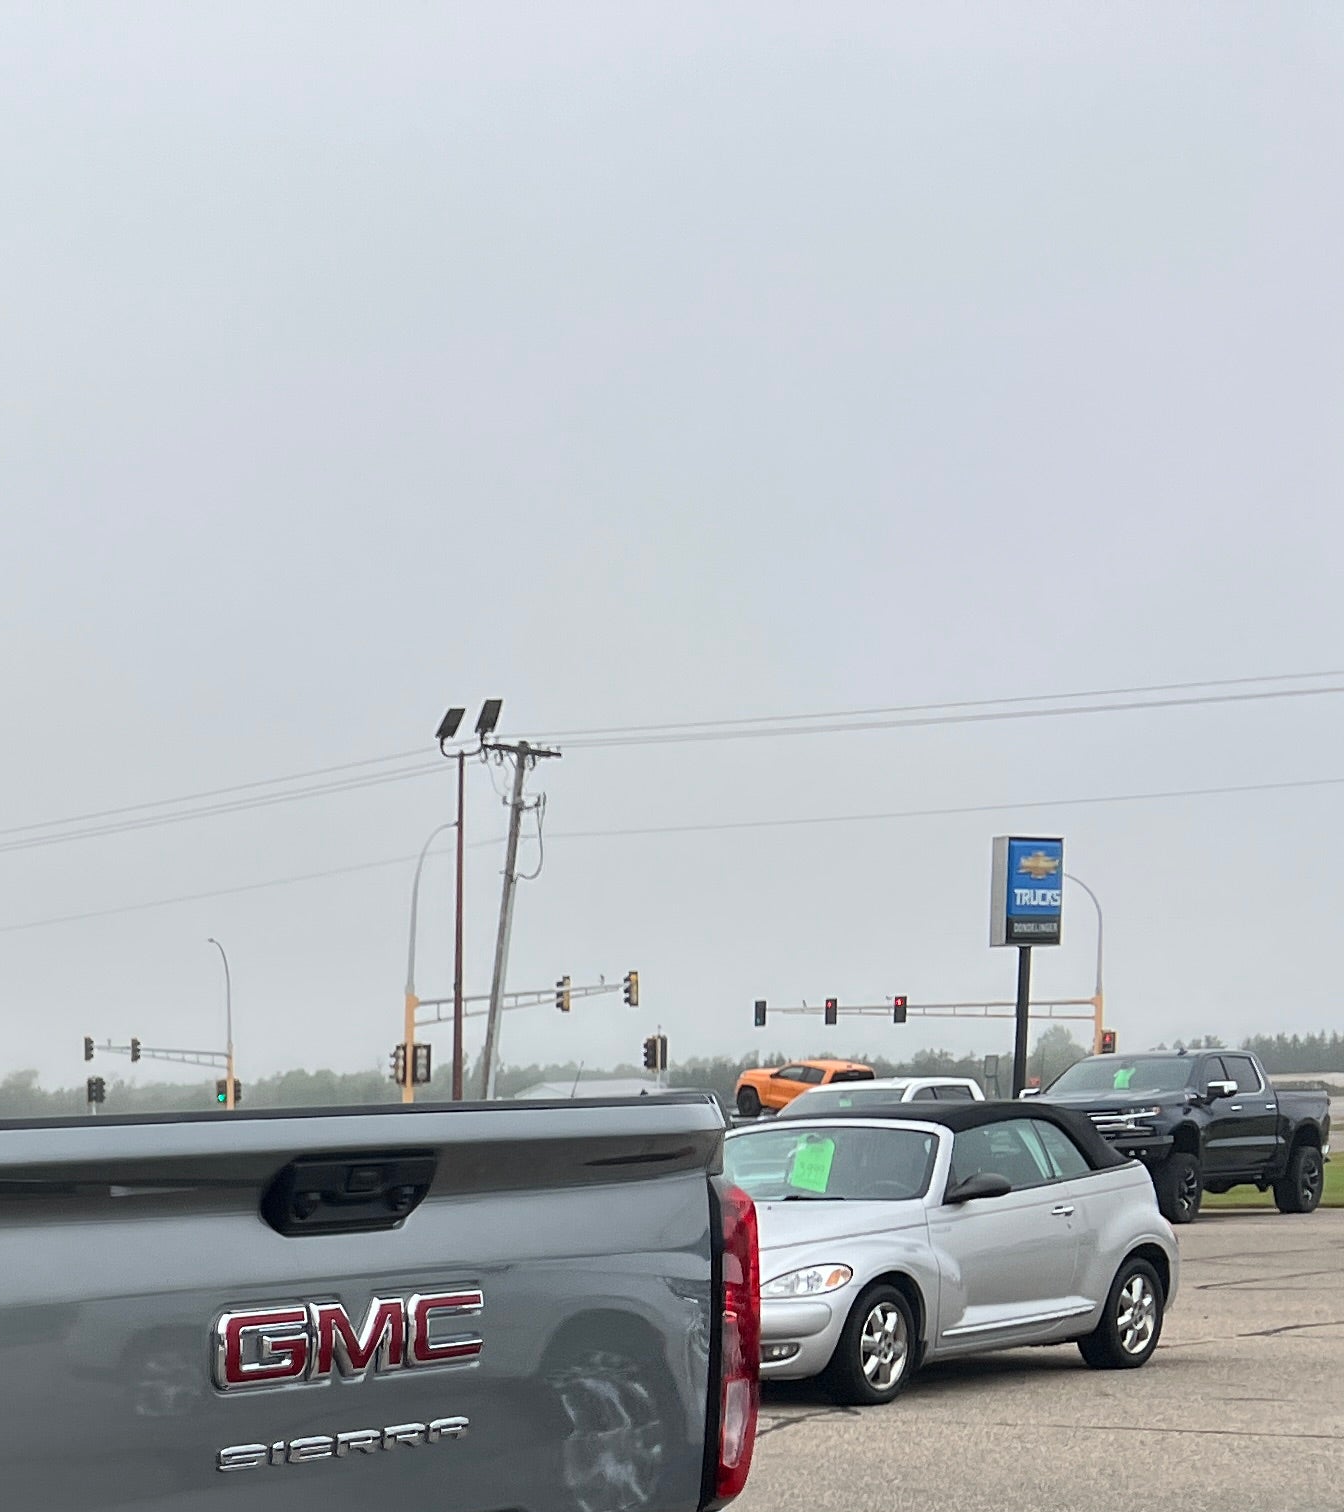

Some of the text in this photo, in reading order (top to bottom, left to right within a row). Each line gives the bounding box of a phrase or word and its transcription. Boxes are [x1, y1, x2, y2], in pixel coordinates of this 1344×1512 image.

[1014, 889, 1061, 906] TRUCKS
[214, 1289, 485, 1391] GMC
[216, 1416, 470, 1472] SIERRA
